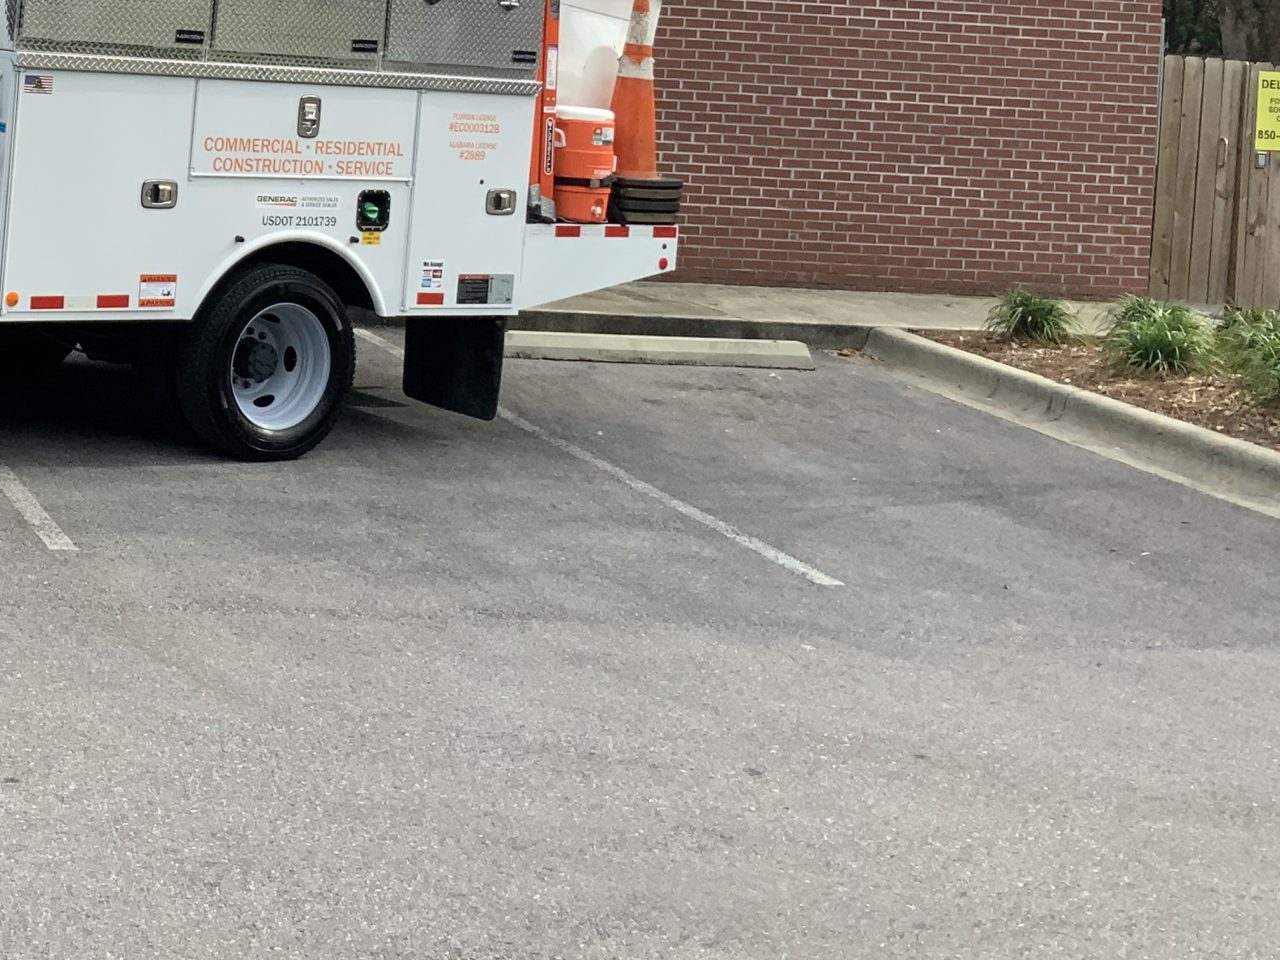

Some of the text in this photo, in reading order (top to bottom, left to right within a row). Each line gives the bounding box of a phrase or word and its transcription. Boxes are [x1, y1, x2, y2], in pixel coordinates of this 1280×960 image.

[204, 136, 404, 157] COMMERCIAL RESIDENTIAL
[212, 157, 394, 176] CONSTRUCTION SERVICE
[256, 195, 298, 203] GENERAC
[262, 215, 337, 227] USDOT 2101739
